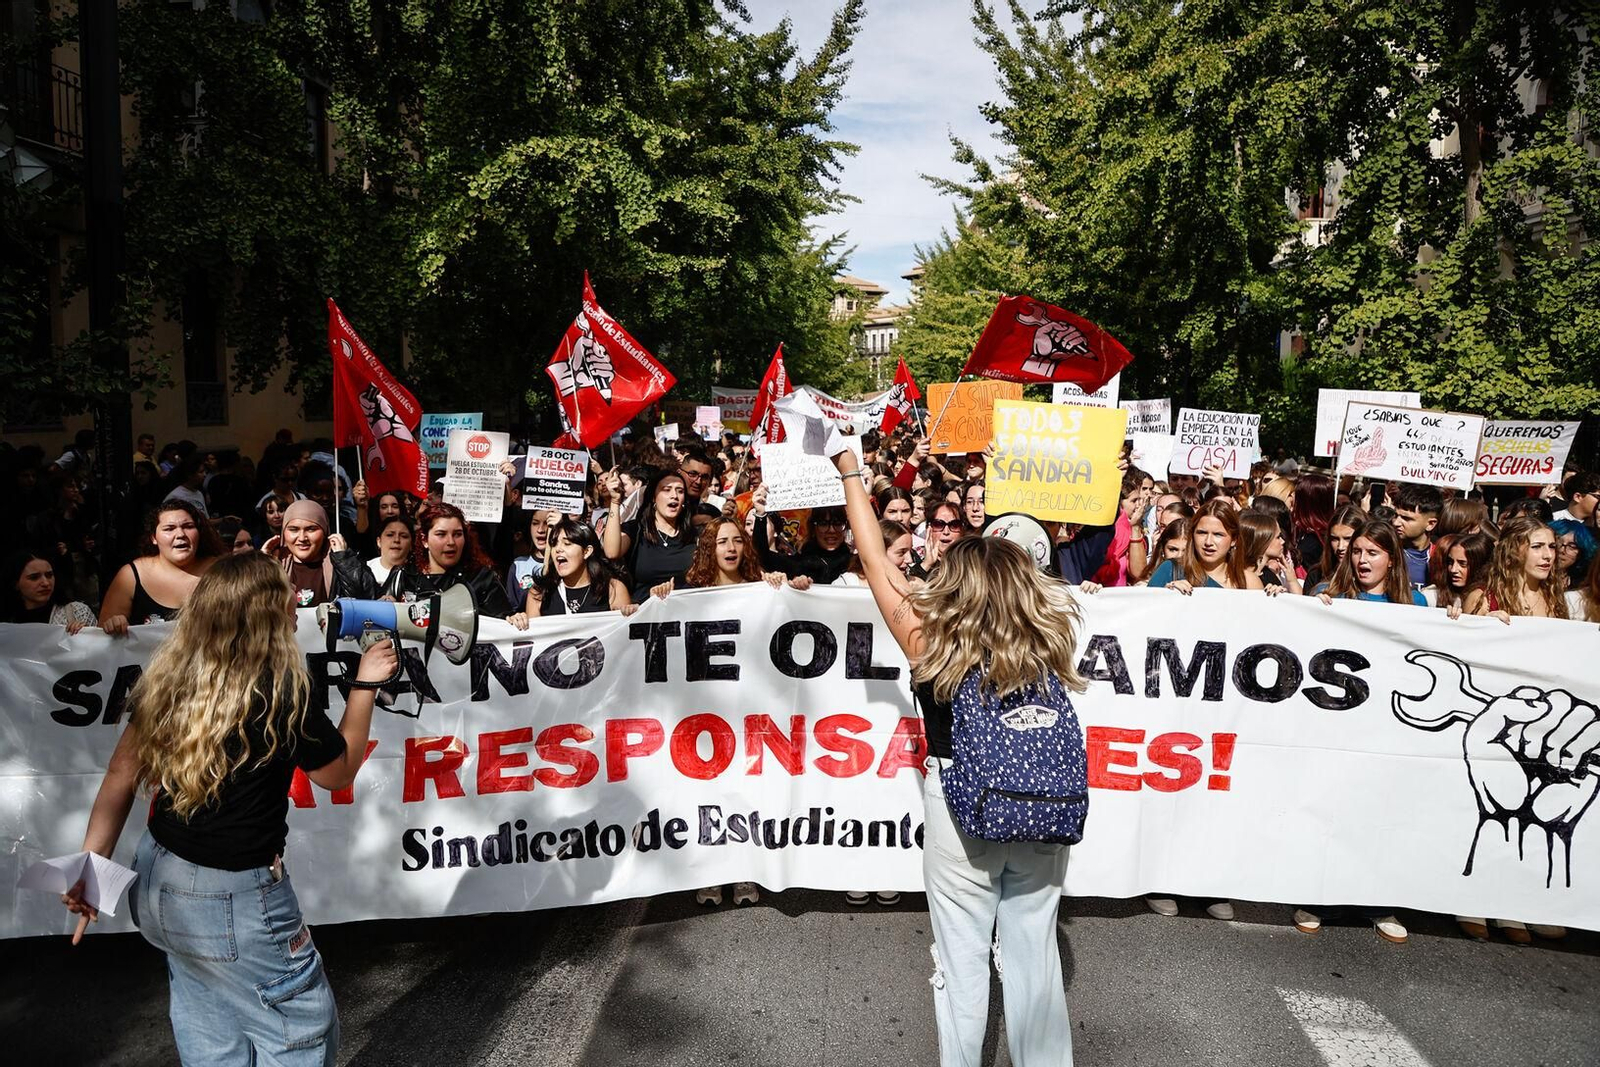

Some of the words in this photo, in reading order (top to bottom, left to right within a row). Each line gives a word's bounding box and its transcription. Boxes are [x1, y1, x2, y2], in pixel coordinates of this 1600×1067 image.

[612, 331, 667, 384] Estudiantes
[1184, 412, 1194, 421] LA
[1247, 416, 1259, 426] NO
[1181, 423, 1220, 434] EMPIEZA
[1223, 426, 1237, 435] EN
[1241, 428, 1253, 437] LA
[1483, 424, 1564, 439] QUEREMOS
[431, 439, 445, 448] NO
[468, 442, 490, 453] STOP
[996, 433, 1080, 459] SOMOS
[1181, 434, 1220, 446] ESCUELA
[1241, 438, 1253, 447] EN
[541, 450, 552, 458] 28
[554, 451, 576, 460] OCT
[1399, 441, 1464, 458] ESTUDIANTES
[529, 458, 584, 474] HUELGA
[1187, 446, 1236, 471] CASA
[1475, 454, 1554, 477] SEGURAS
[471, 468, 497, 477] OCTUBRE
[535, 470, 576, 479] ESTUDIANTIL
[992, 456, 1092, 484] SANDRA
[1401, 466, 1457, 482] BULLYING
[470, 635, 606, 702] NO
[629, 618, 741, 683] TE
[402, 818, 626, 873] Sindicato
[632, 808, 688, 852] de
